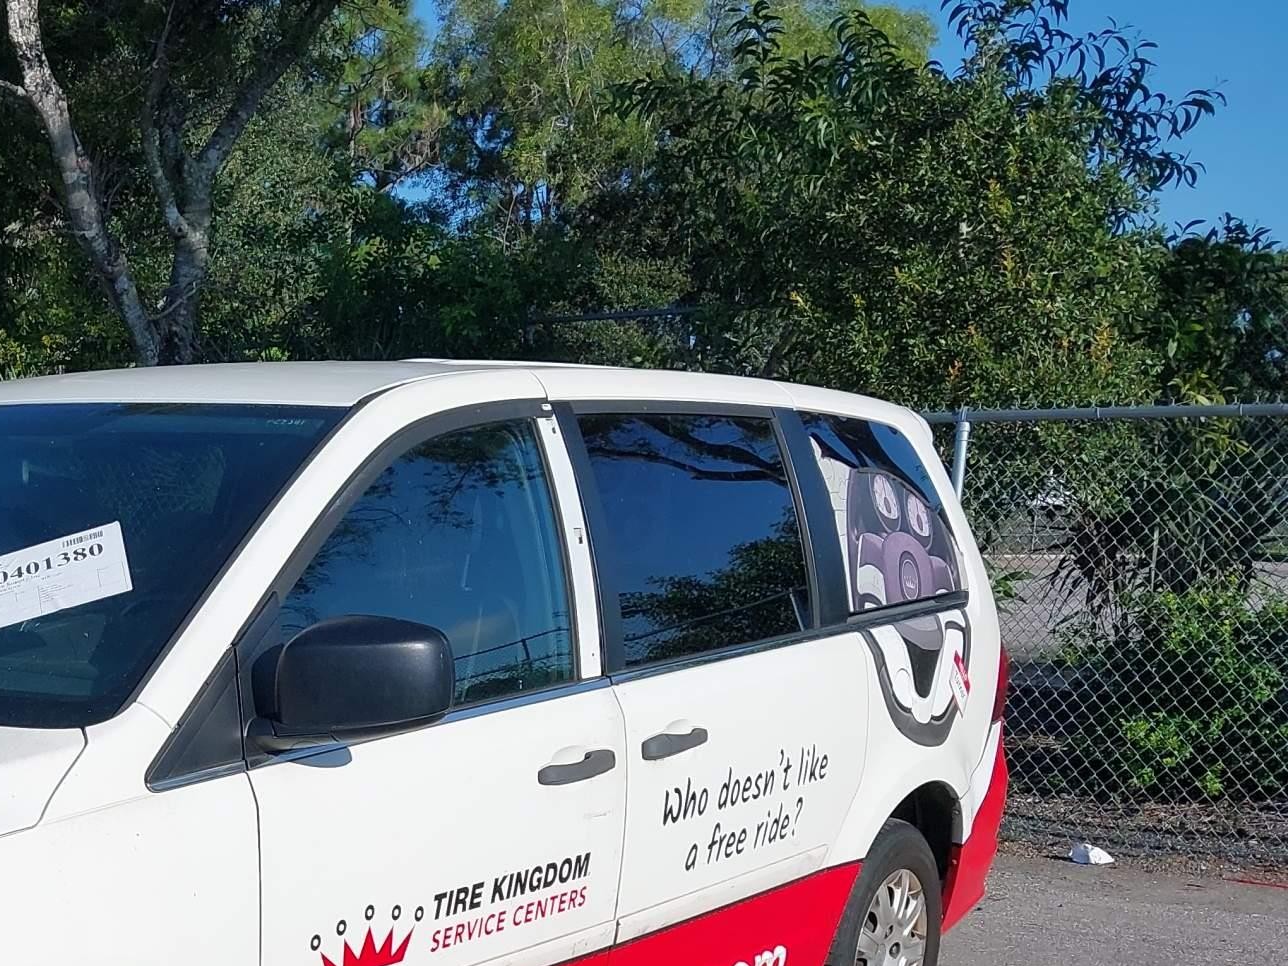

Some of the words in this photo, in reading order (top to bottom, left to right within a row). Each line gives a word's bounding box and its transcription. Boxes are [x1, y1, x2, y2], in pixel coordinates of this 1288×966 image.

[662, 777, 709, 826] Who
[717, 749, 793, 810] doesn't
[797, 743, 830, 786] like
[684, 843, 698, 871] a
[707, 822, 747, 864] free
[753, 797, 803, 849] ride?
[430, 910, 507, 953] SERVICE
[513, 886, 587, 927] CENTERS
[434, 881, 485, 921] TIRE
[491, 852, 592, 905] KINGDOM
